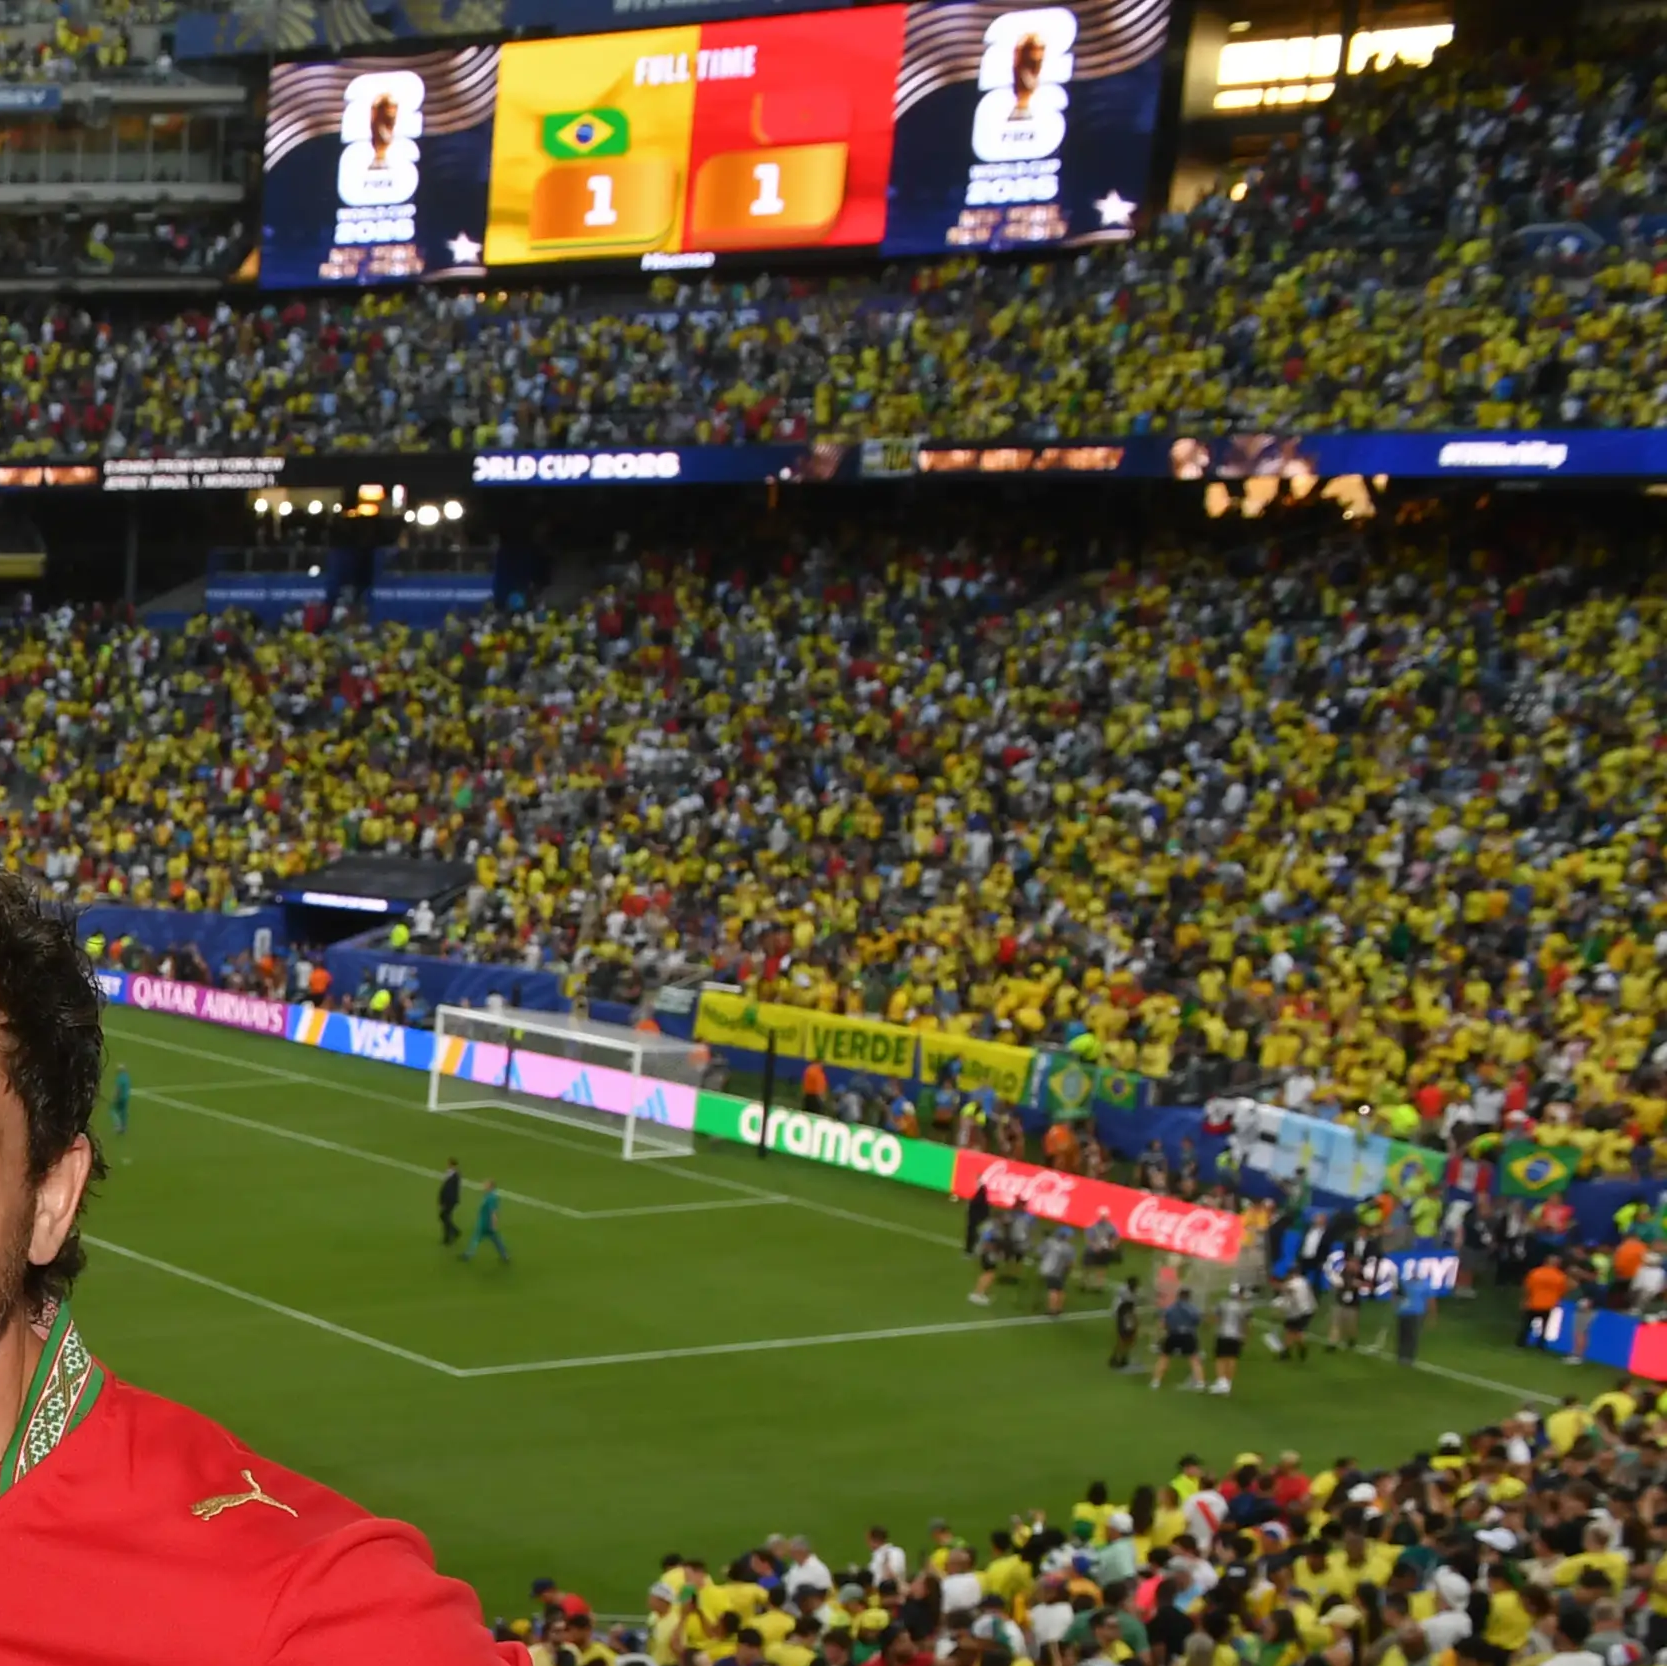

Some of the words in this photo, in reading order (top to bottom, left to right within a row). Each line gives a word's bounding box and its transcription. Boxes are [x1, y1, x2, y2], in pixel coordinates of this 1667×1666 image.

[634, 53, 690, 86] FULL
[696, 45, 758, 82] TIME
[584, 175, 617, 225] 1
[749, 163, 785, 216] 1
[473, 455, 537, 481] ORLD
[537, 454, 591, 480] CUP
[590, 452, 680, 479] 2026
[132, 973, 197, 1009] QATAR
[202, 989, 283, 1033] AIRWAYS
[349, 1017, 405, 1063] VISA
[811, 1025, 908, 1066] VERDE
[739, 1103, 902, 1176] aramco
